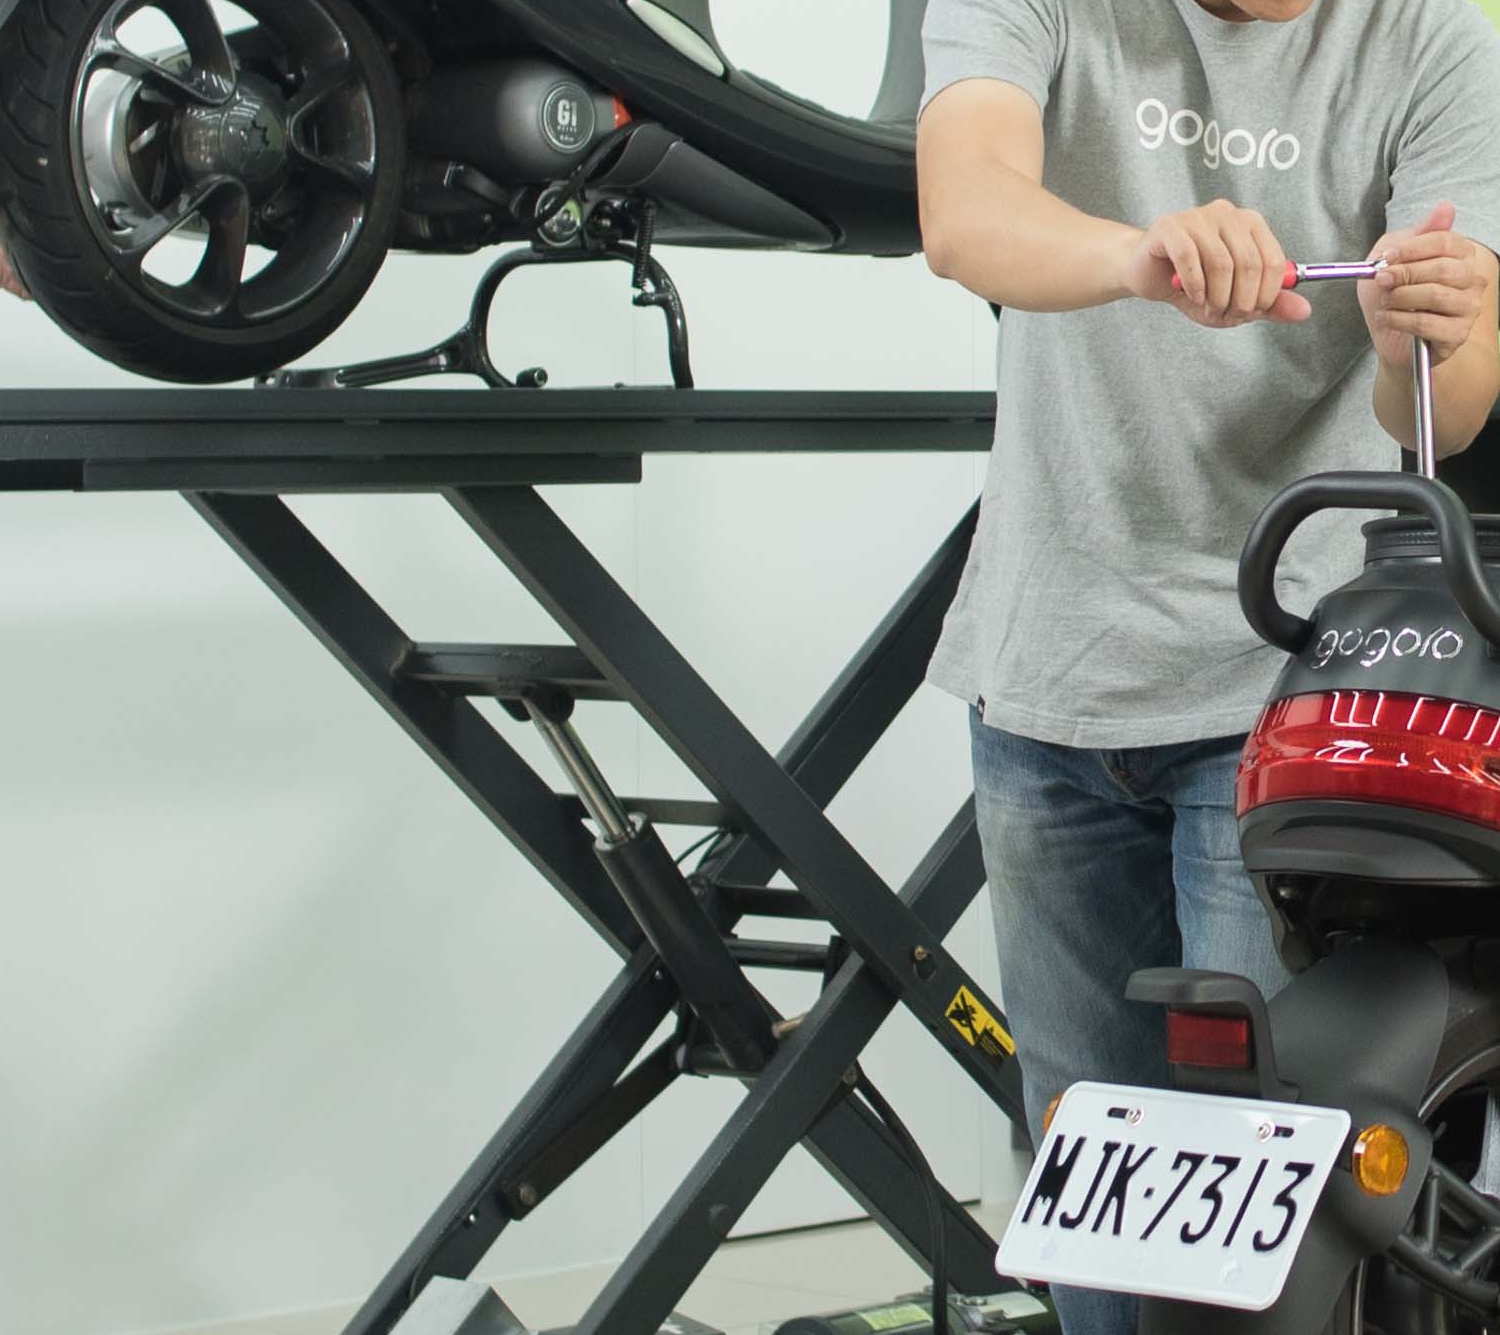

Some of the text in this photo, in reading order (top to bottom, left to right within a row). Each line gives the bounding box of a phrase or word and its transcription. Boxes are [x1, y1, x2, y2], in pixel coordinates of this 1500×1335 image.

[557, 98, 578, 127] G1
[1135, 97, 1301, 171] gogoro
[1310, 627, 1464, 670] gogoro
